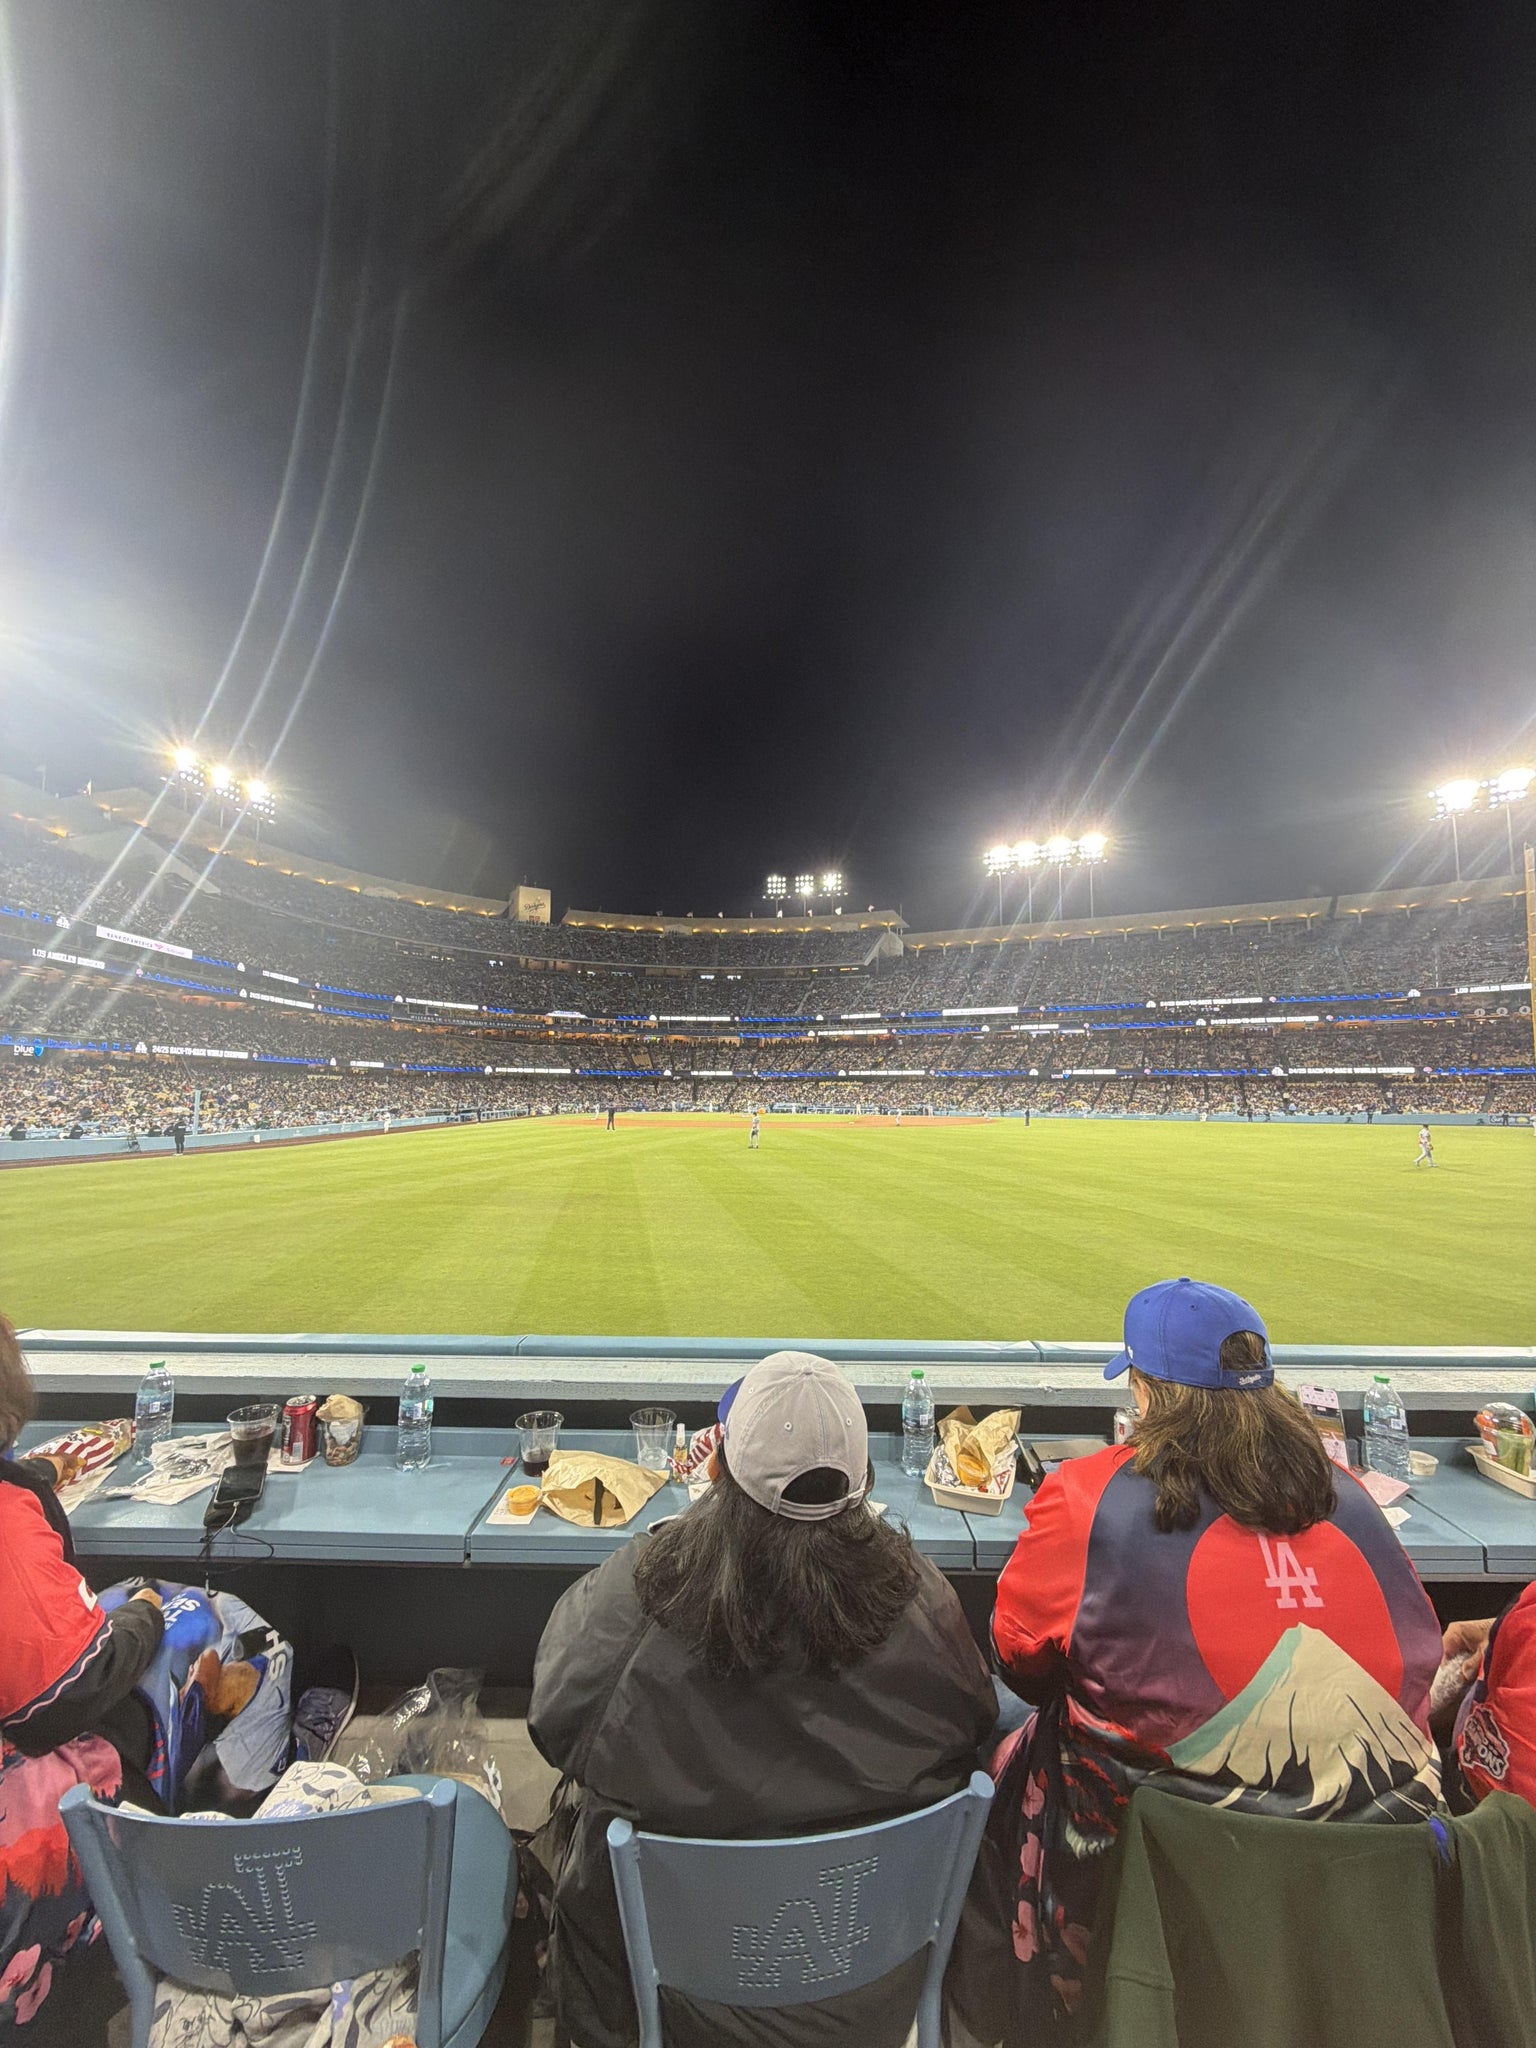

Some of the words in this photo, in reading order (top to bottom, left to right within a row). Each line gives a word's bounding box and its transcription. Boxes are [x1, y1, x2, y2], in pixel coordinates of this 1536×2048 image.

[107, 932, 122, 940] BANK
[131, 939, 153, 948] AMERICA
[32, 948, 46, 958] LOS
[14, 1045, 35, 1053] blue
[152, 1045, 170, 1054] 24/25
[1257, 1532, 1325, 1609] LA
